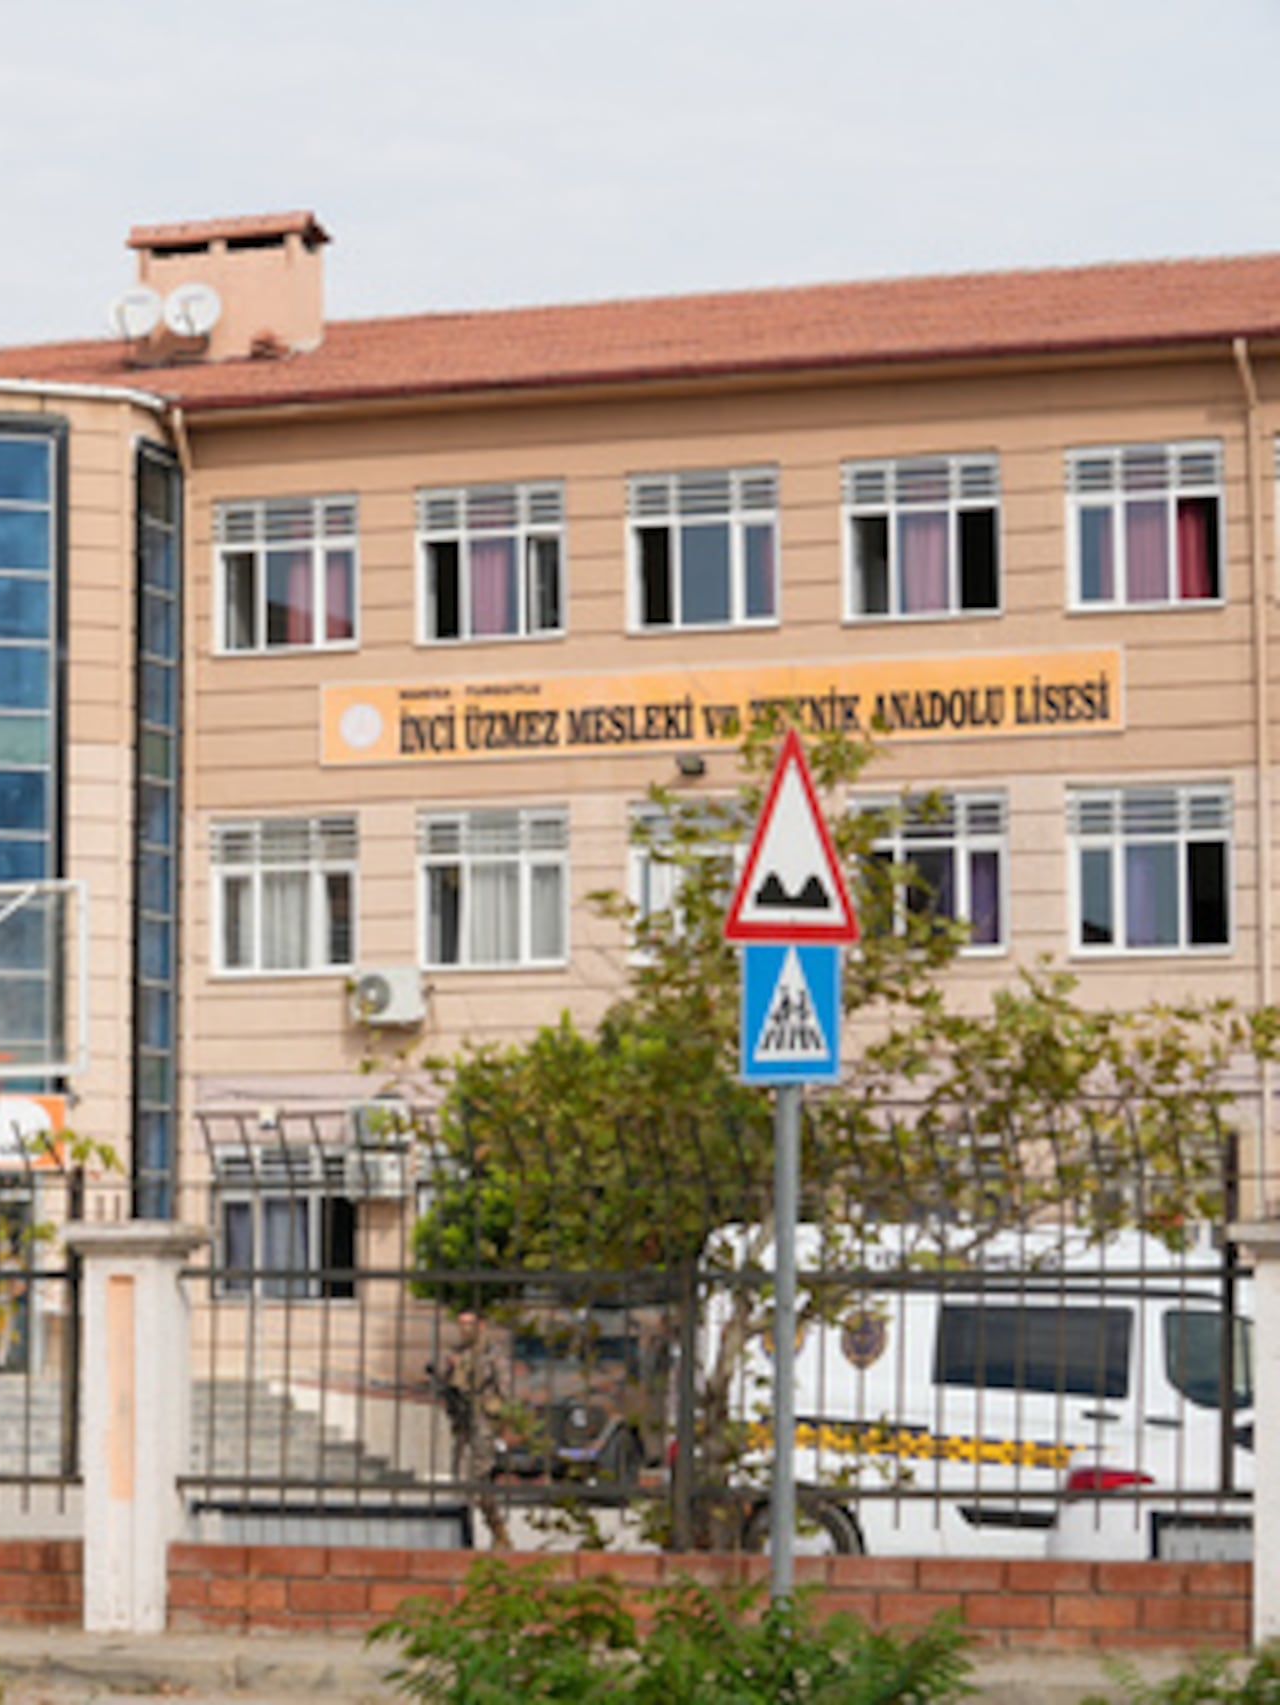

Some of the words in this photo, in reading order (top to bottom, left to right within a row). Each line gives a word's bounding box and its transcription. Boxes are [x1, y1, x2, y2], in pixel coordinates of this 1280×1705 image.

[464, 703, 560, 750] ÜZMEZ
[566, 692, 695, 746] MESLEKİ
[1014, 669, 1111, 726] LİSESİ
